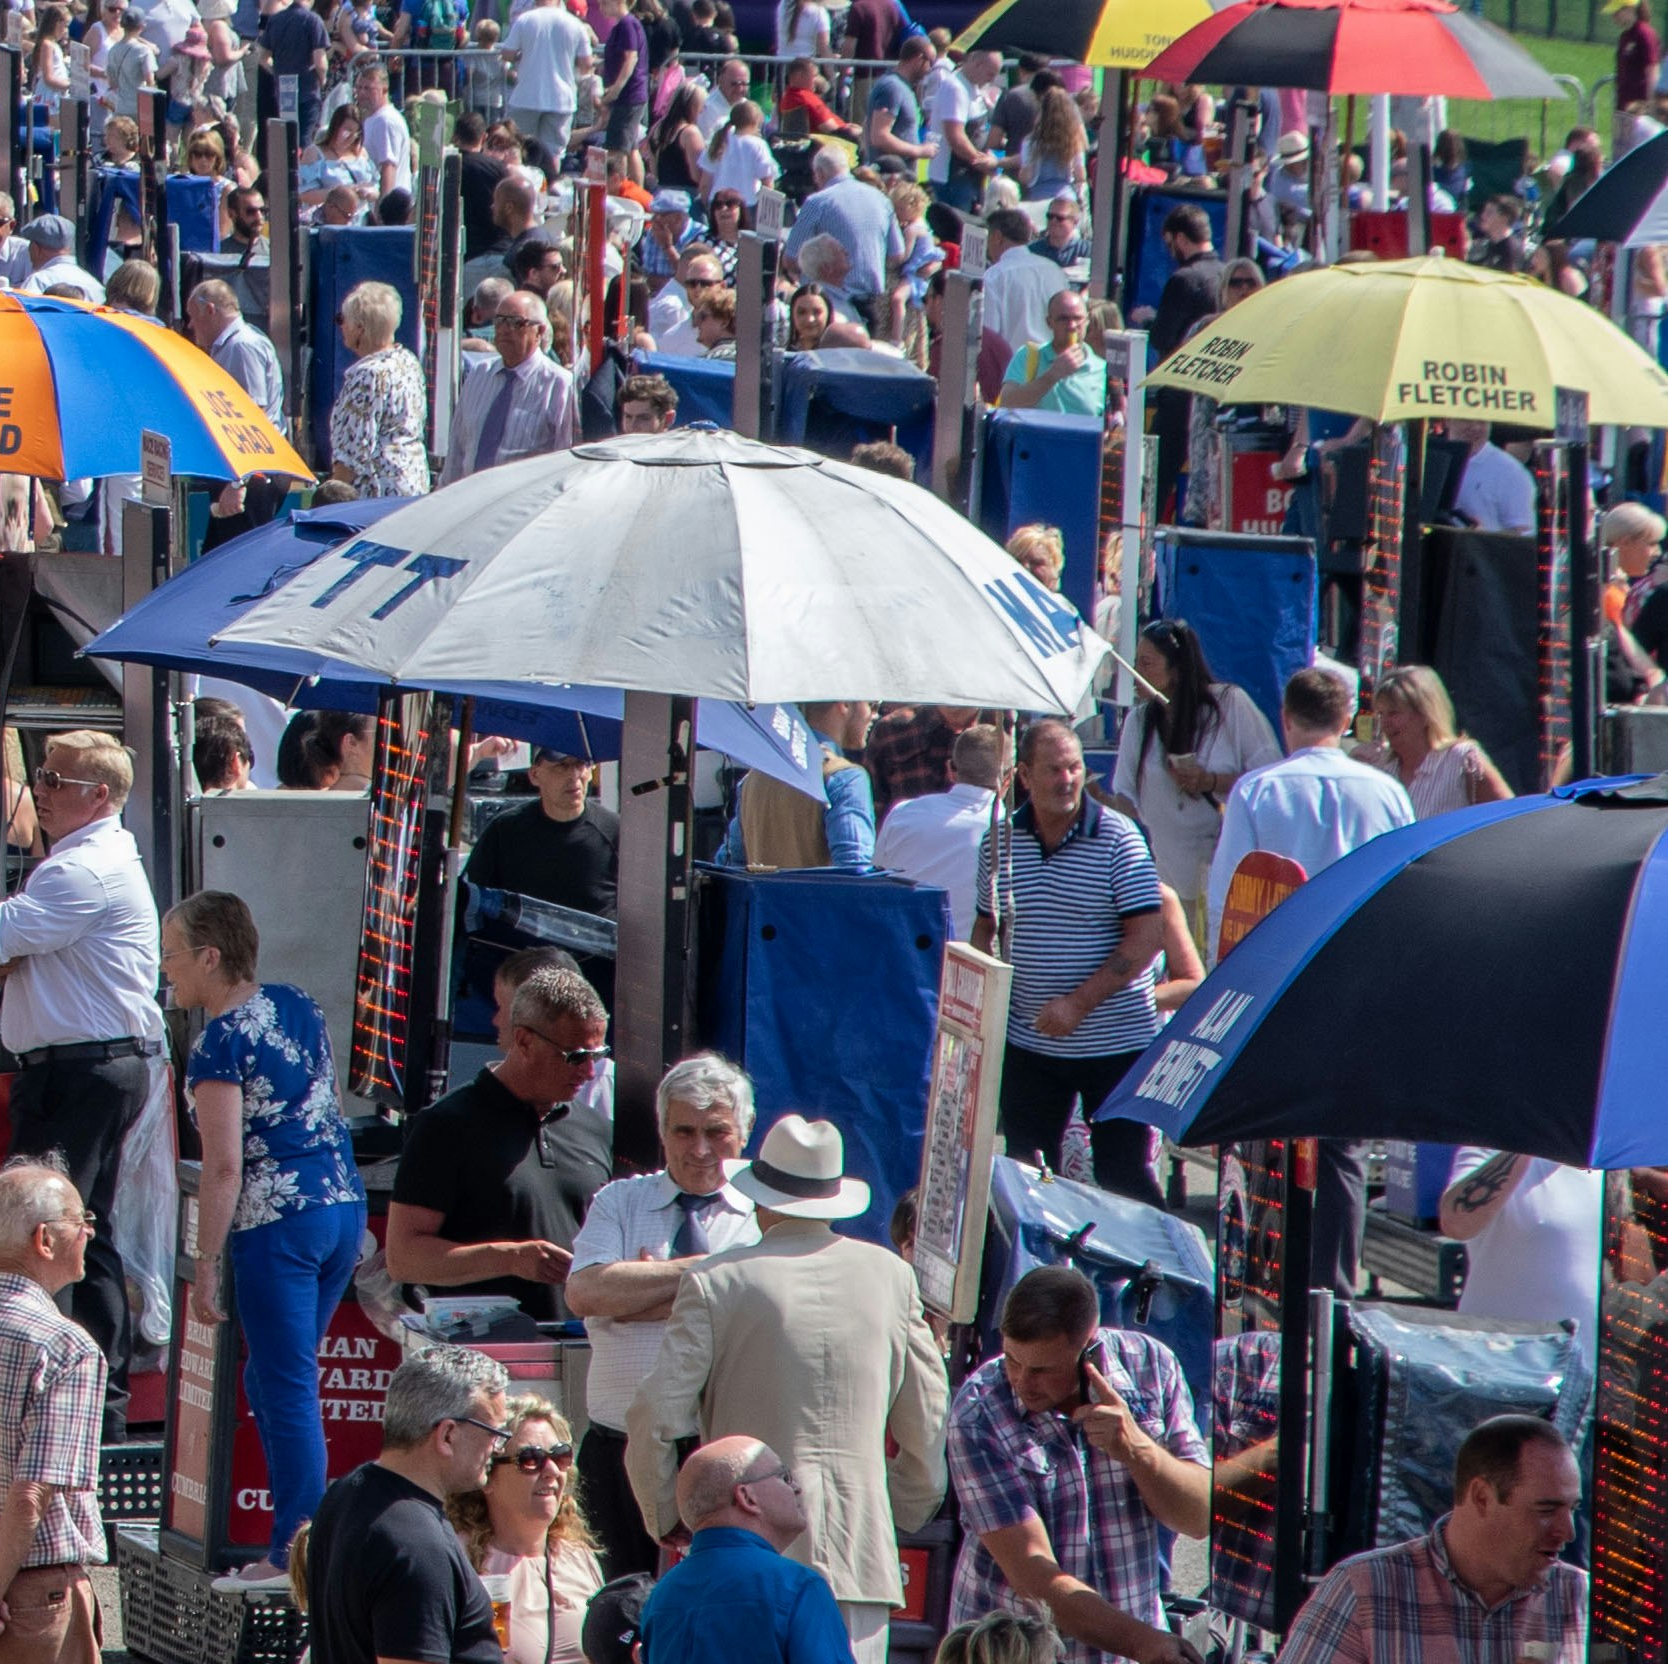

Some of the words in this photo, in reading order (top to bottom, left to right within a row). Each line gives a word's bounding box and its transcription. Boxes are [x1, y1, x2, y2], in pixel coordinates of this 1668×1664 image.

[1144, 33, 1173, 46] TON
[1200, 336, 1254, 361] ROBIN
[1164, 353, 1243, 385] FLETCHER
[1423, 360, 1507, 385] ROBIN
[203, 390, 244, 419] JOE
[1398, 383, 1538, 412] FLETCHER
[222, 424, 276, 455] CHAD
[1189, 989, 1255, 1044] ALAN
[1135, 1039, 1223, 1111] BENNETT
[186, 1320, 214, 1349] BRIAN
[316, 1336, 379, 1359] IAN
[318, 1368, 395, 1391] ARD
